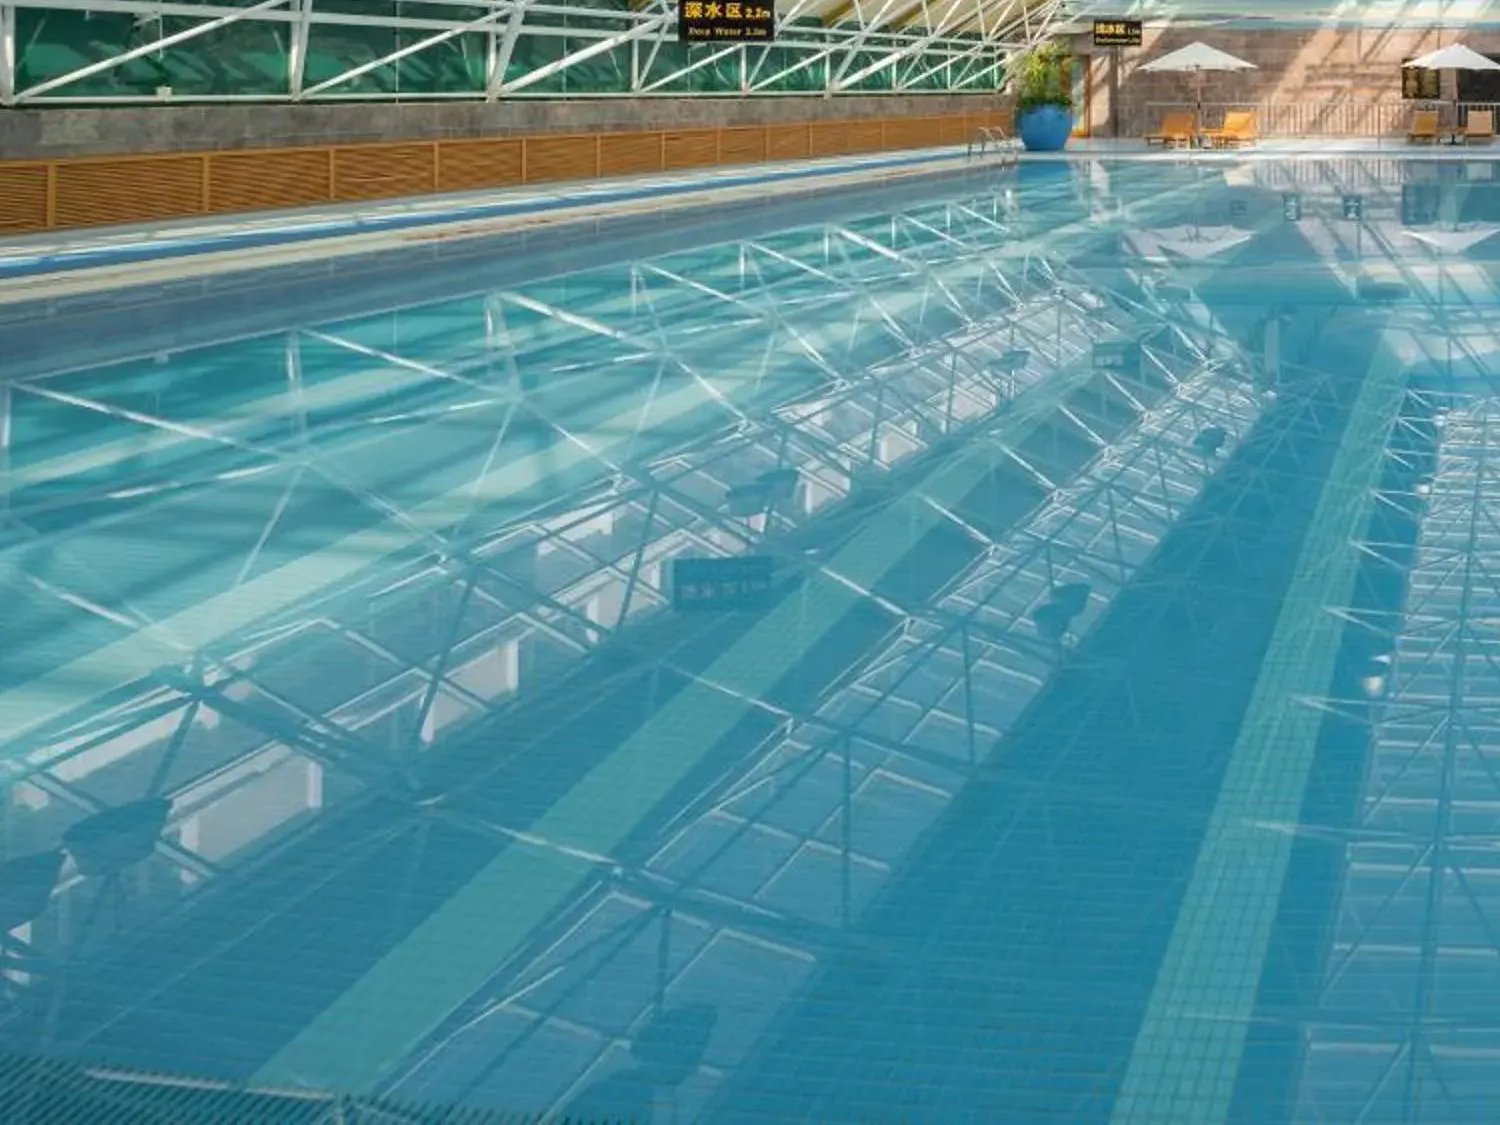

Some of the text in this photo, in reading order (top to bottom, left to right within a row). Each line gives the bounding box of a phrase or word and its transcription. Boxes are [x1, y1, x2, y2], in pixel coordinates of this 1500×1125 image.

[685, 1, 742, 19] 深水区
[715, 27, 742, 36] Water
